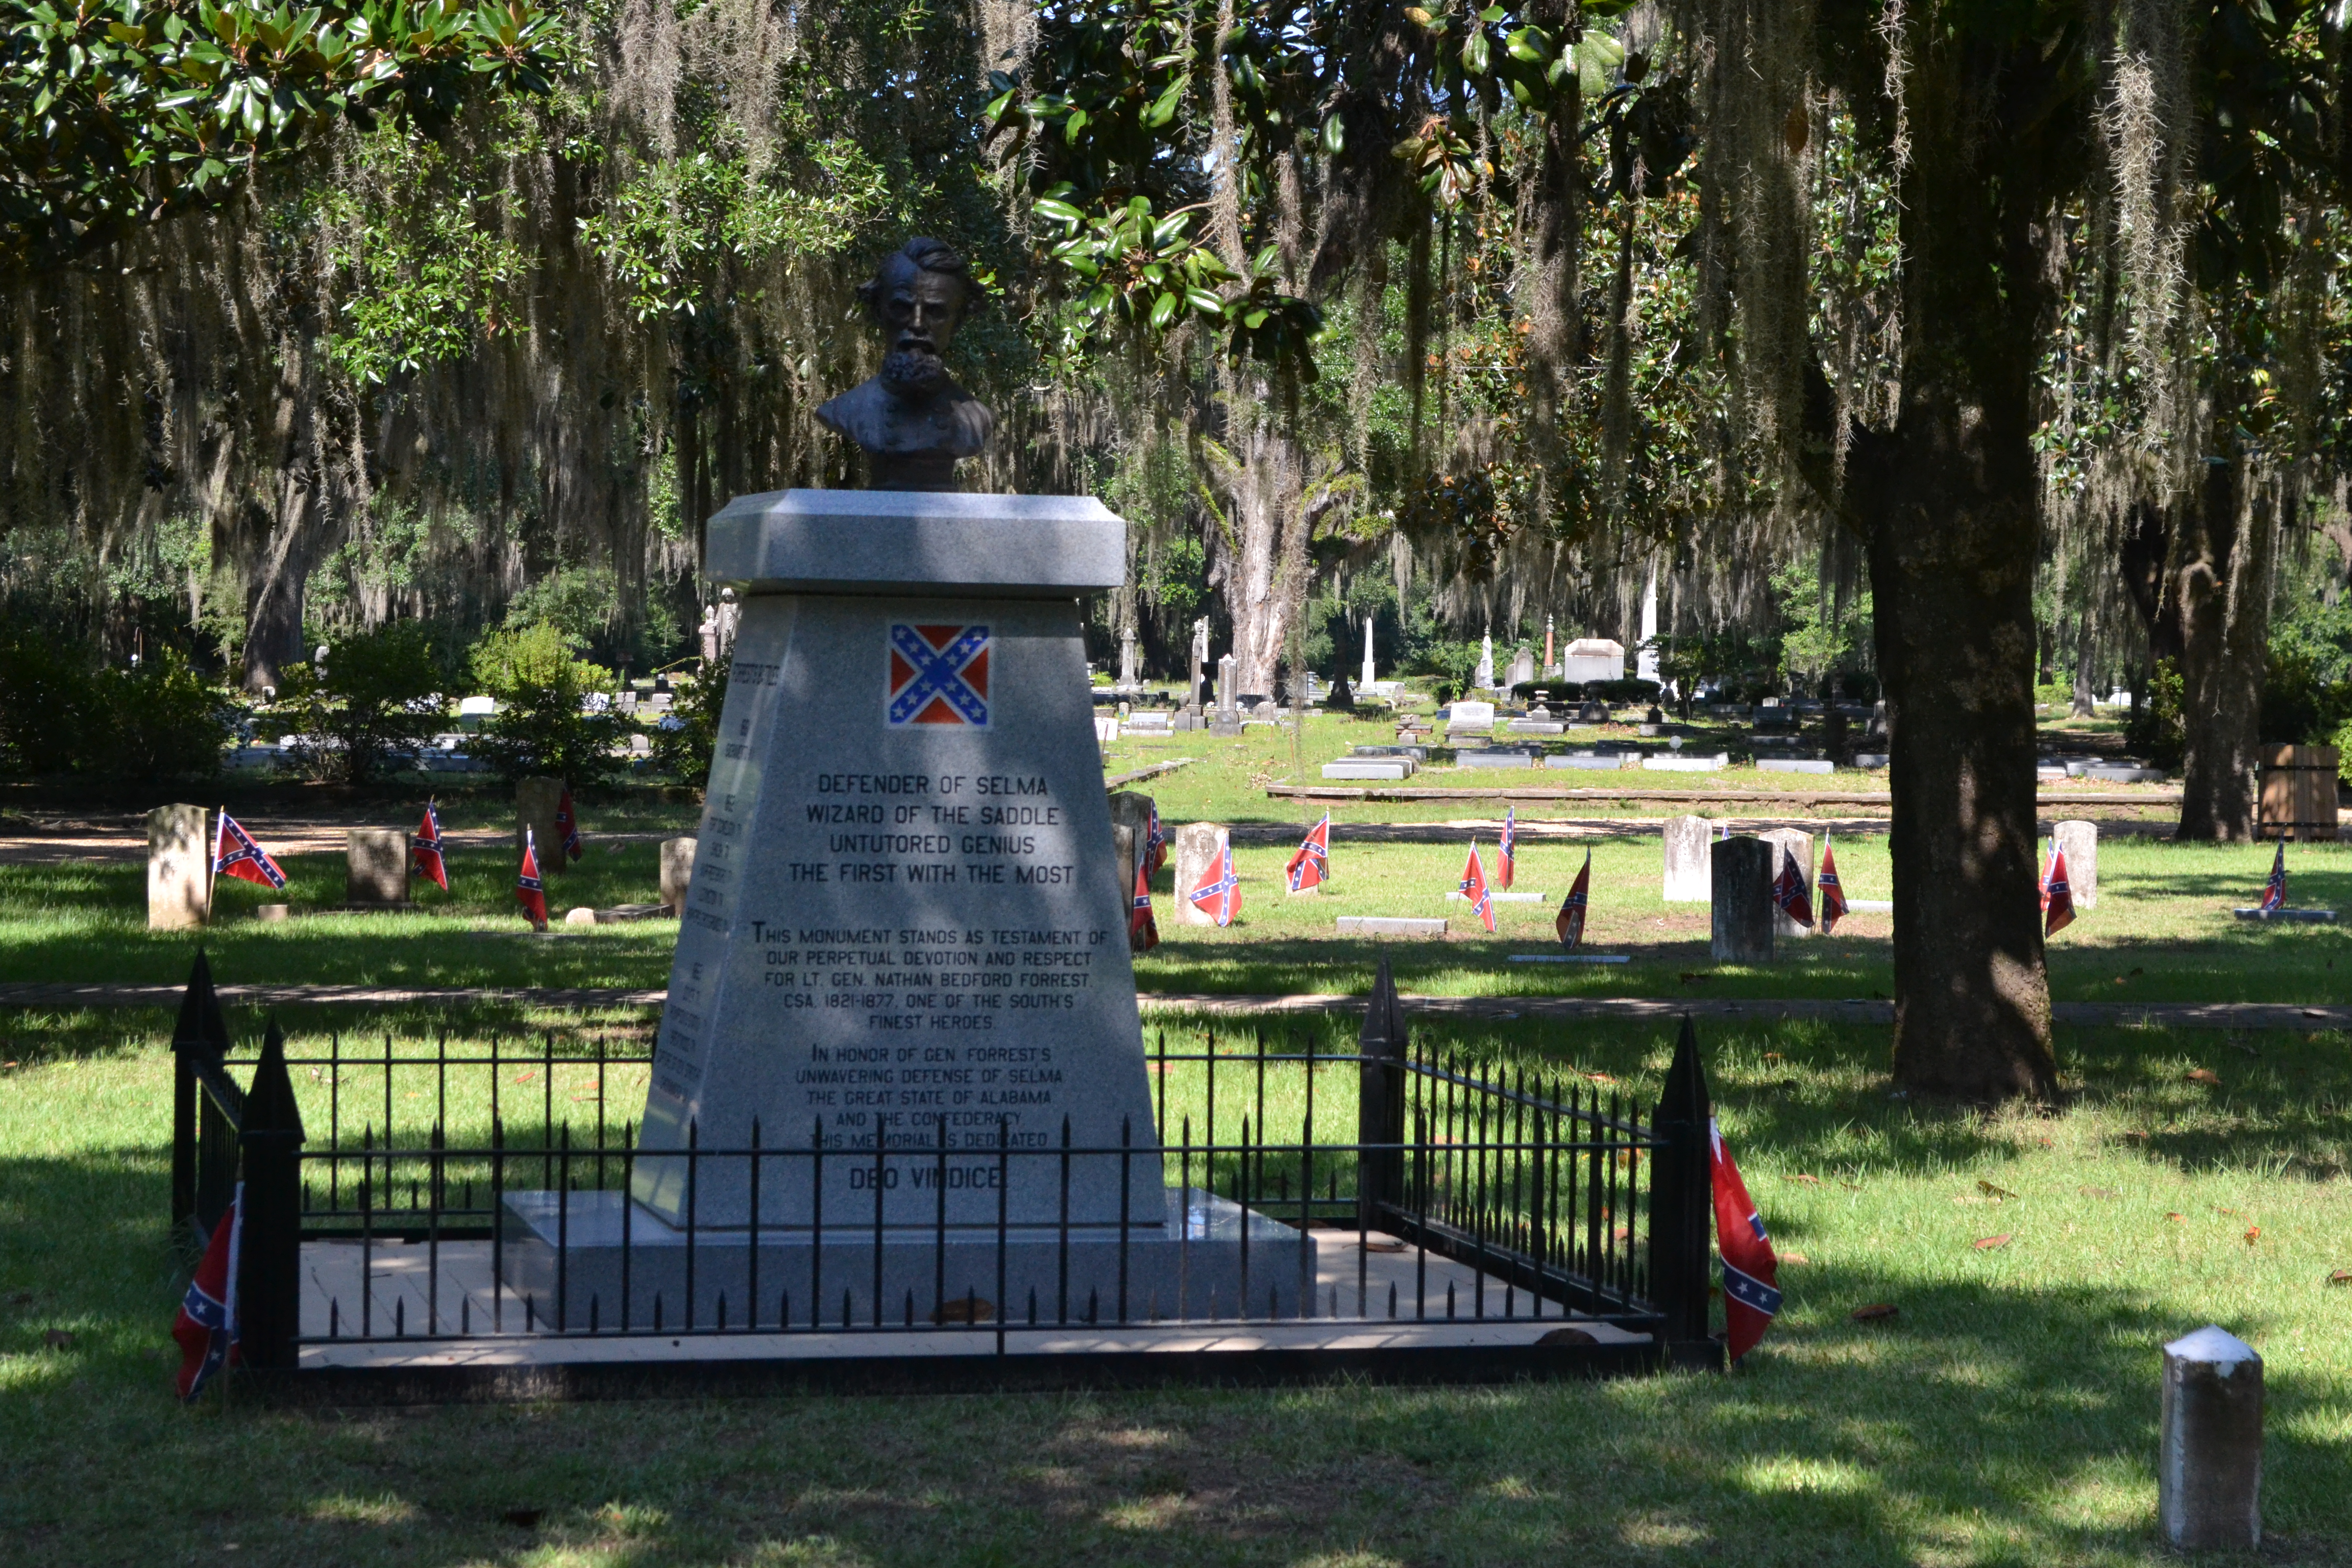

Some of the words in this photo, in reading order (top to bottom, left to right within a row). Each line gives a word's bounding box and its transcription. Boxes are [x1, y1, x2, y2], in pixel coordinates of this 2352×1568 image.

[819, 774, 929, 793] DEFENDER
[940, 776, 966, 794] OF
[977, 776, 1048, 795] SELMA
[806, 804, 884, 824] WIZARD
[895, 805, 921, 824] OF
[931, 806, 969, 824] THE
[981, 806, 1060, 825] SADDLE
[830, 835, 950, 853] UNTUTORED
[962, 836, 1035, 854] GENIUS
[789, 863, 828, 882] THE
[840, 864, 897, 883] FIRST
[907, 864, 956, 883] WITH
[967, 865, 1004, 883] THE
[1016, 866, 1073, 884] MOST
[752, 921, 791, 944] THIS
[799, 929, 892, 944] MONUMENT
[899, 929, 957, 944] STANDS
[965, 930, 984, 944] AS
[992, 930, 1081, 945] TESTAMENT
[1089, 931, 1108, 945] OF
[767, 950, 798, 965] OUR
[806, 950, 896, 965] PERPETUAL
[903, 951, 978, 966] DEVOTION
[986, 951, 1015, 966] AND
[1023, 952, 1092, 966] RESPECT
[765, 972, 795, 986] FOR
[831, 972, 867, 986] GEN.
[875, 972, 933, 987] NATHAN
[941, 973, 1012, 987] BEDFORD
[906, 994, 937, 1009] ONE
[945, 995, 964, 1009] OF
[973, 995, 1001, 1009] THE
[1010, 995, 1073, 1009] SOUTH'S
[869, 1015, 923, 1029] FINEST
[812, 1043, 828, 1062] IN
[837, 1048, 889, 1062] HONOR
[897, 1048, 918, 1062] OF
[968, 1048, 1051, 1062] FORREST'S
[796, 1069, 893, 1084] UNWAVERING
[902, 1069, 973, 1084] DEFENSE
[982, 1069, 1002, 1084] OF
[1009, 1069, 1062, 1083] SELMA
[808, 1090, 837, 1105] THE
[845, 1091, 893, 1105] GREAT
[901, 1091, 945, 1105] STATE
[953, 1090, 973, 1105] OF
[981, 1090, 1051, 1105] ALABAMA
[837, 1112, 866, 1126] AND
[912, 1112, 1021, 1126] CONFEDERACY
[965, 1133, 1047, 1147] DEDIATED
[850, 1168, 898, 1189] DEO
